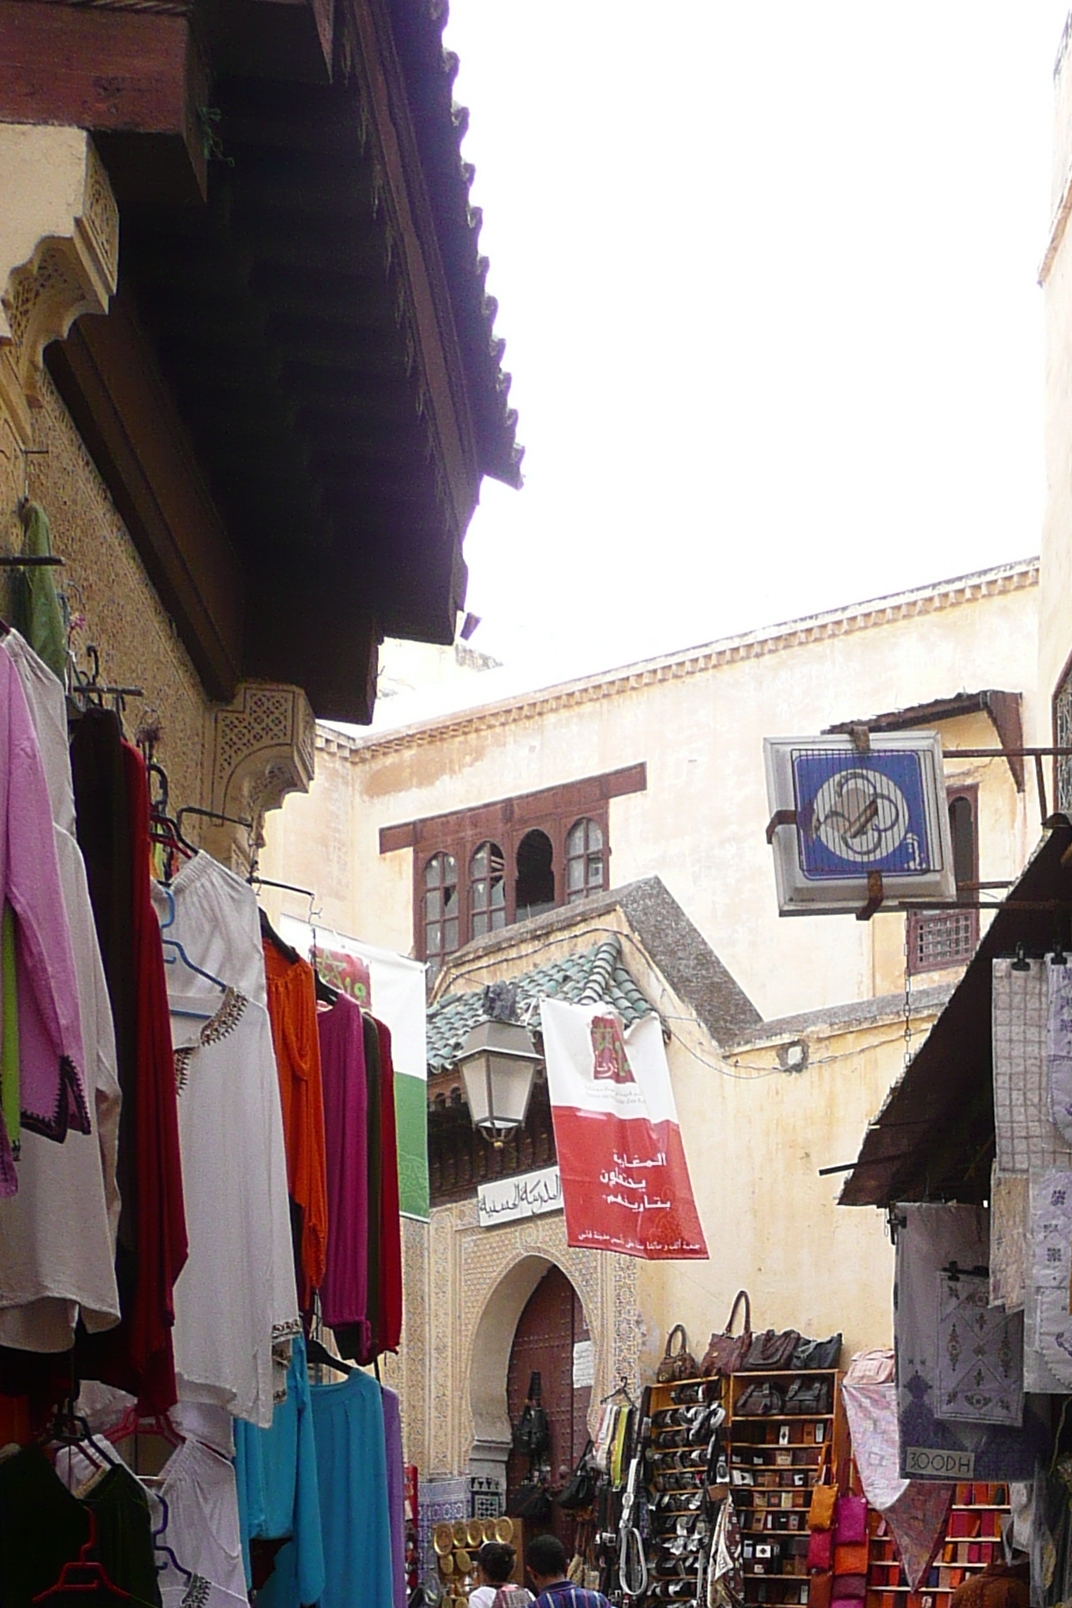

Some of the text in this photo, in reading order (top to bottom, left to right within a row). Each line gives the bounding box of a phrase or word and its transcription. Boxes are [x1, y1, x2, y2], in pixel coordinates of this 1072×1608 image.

[612, 1149, 667, 1168] المغاربة
[599, 1167, 647, 1192] يحتفلون
[909, 1452, 971, 1473] 300DH
